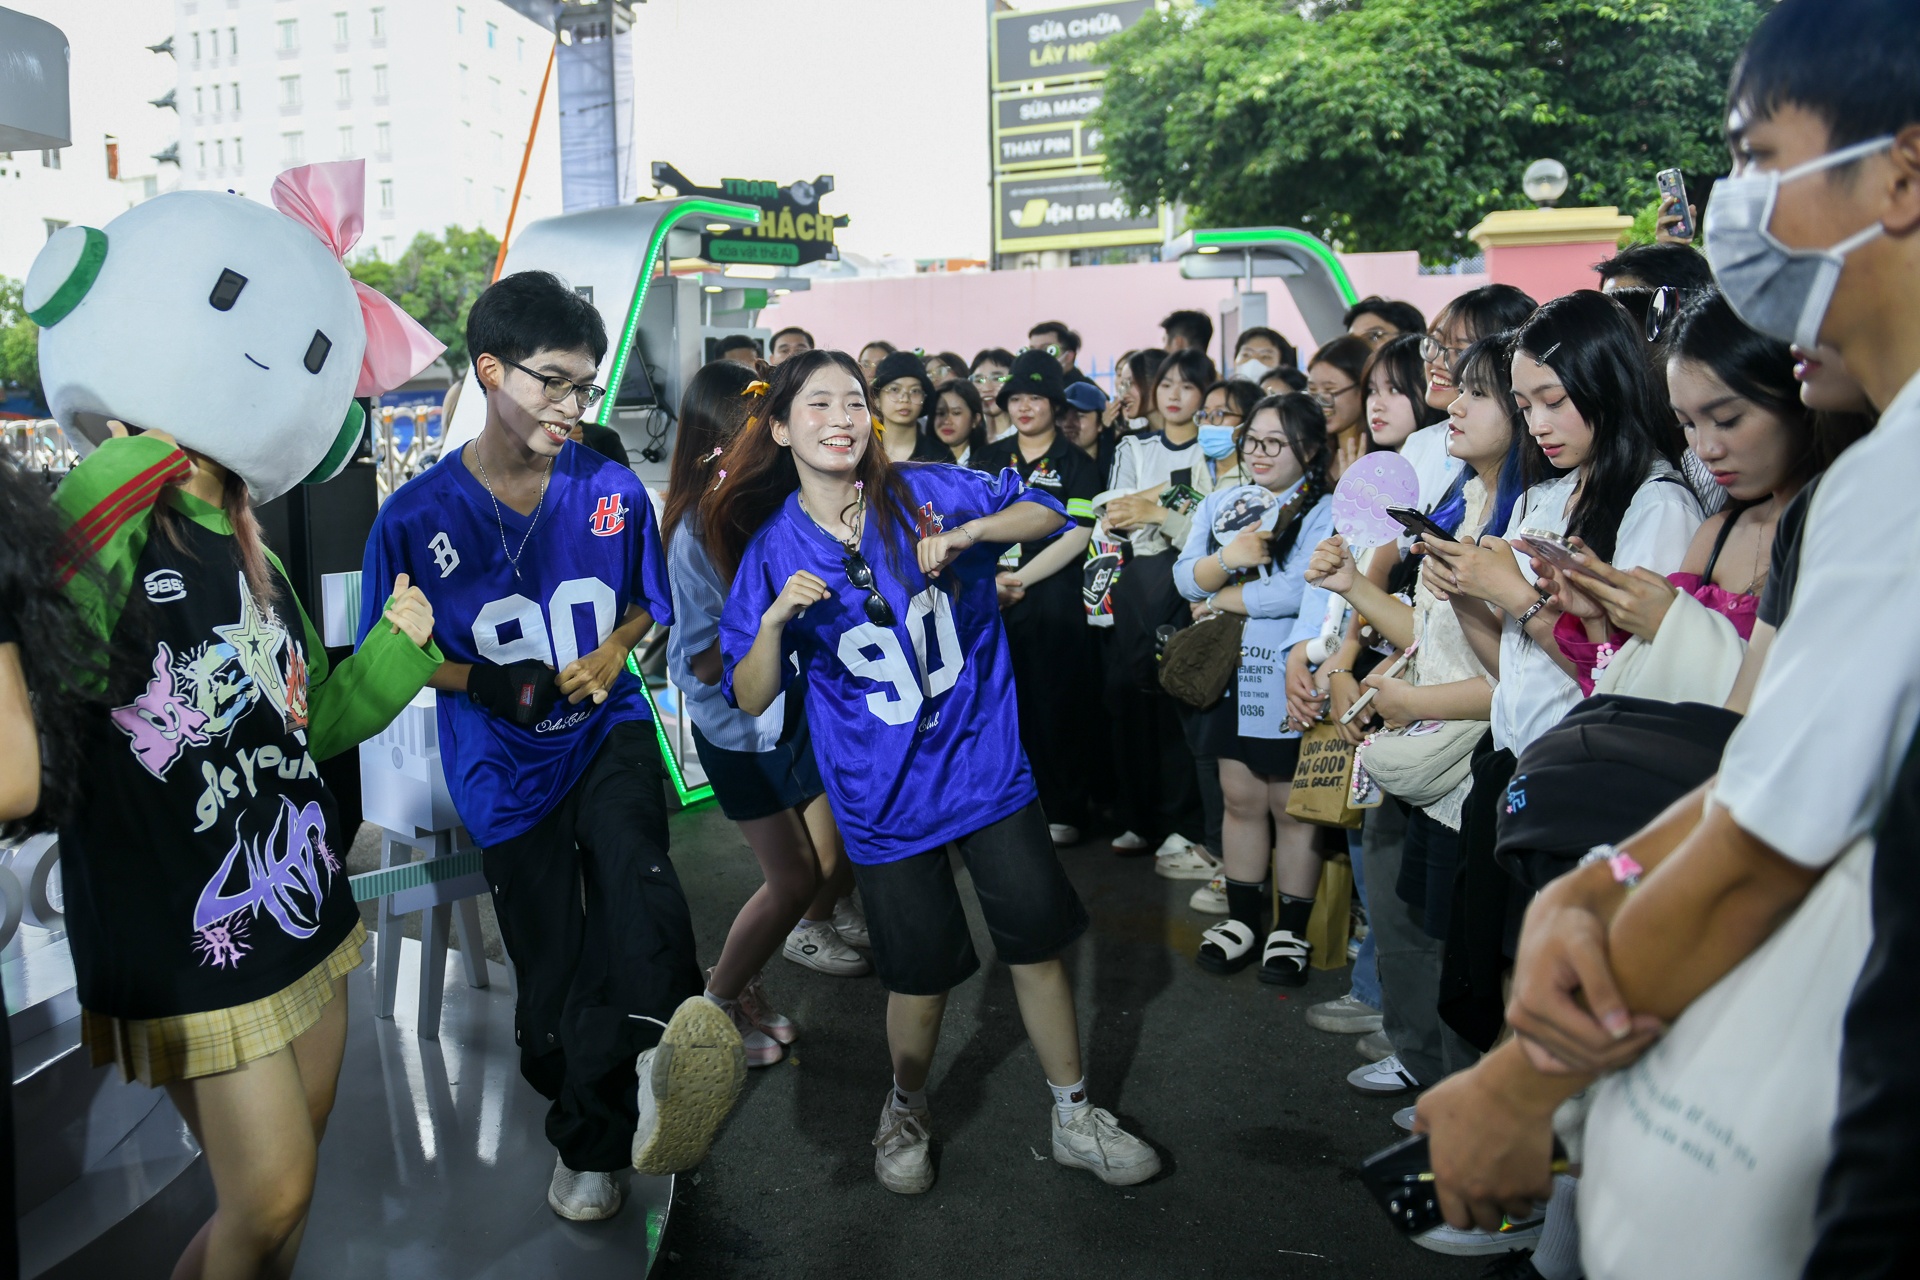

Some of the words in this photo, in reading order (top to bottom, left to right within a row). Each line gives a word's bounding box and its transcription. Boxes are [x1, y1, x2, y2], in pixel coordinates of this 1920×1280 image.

[1002, 139, 1042, 158] THAY
[1043, 136, 1072, 155] PIN
[725, 180, 779, 201] TRẠM
[1076, 204, 1095, 220] DI
[742, 206, 834, 242] HÁCH
[471, 576, 617, 673] 90
[837, 584, 965, 726] 90
[1238, 664, 1274, 675] EMENTS
[1240, 704, 1265, 717] 0336
[918, 711, 940, 733] Club
[1303, 741, 1323, 756] LOOK
[1298, 758, 1312, 775] DO
[1312, 755, 1346, 774] GOOD
[1293, 778, 1309, 790] FEEL
